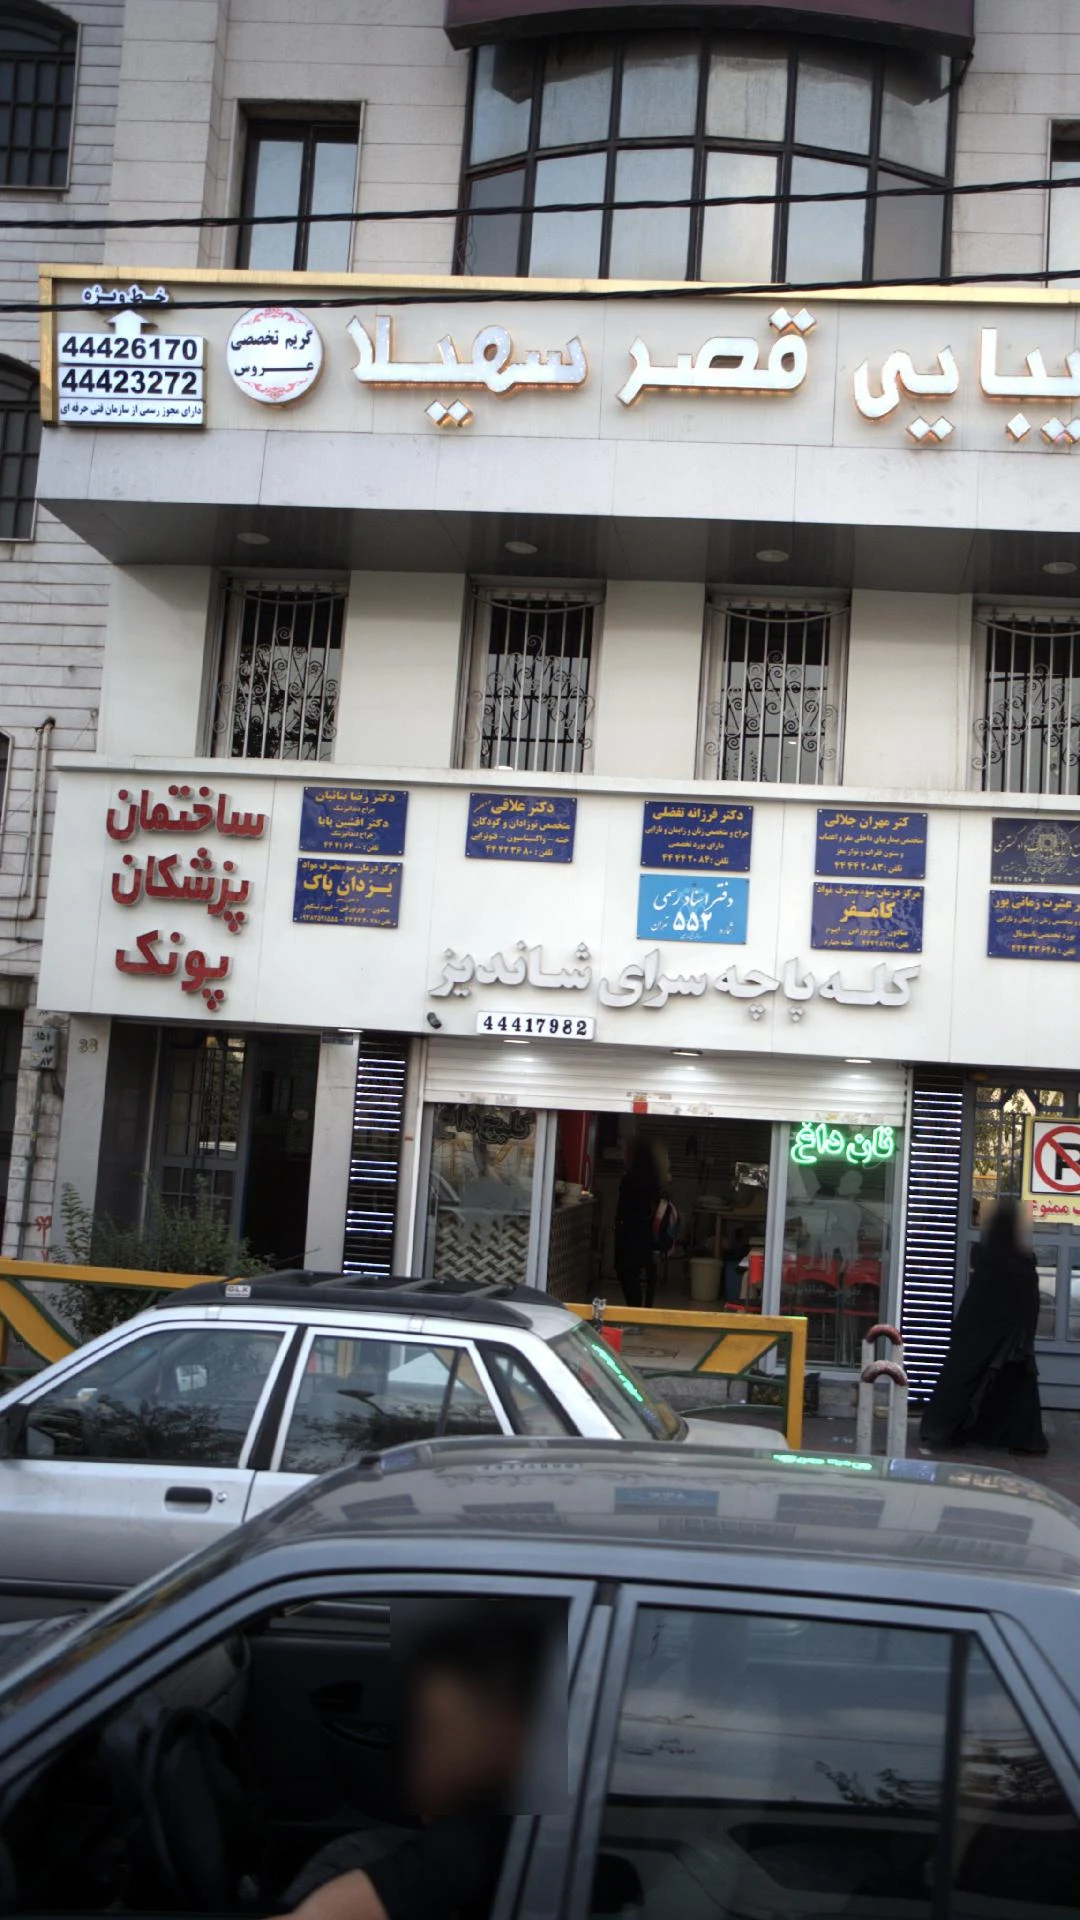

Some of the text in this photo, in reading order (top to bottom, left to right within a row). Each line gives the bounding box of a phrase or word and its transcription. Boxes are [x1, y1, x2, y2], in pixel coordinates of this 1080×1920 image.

[231, 329, 313, 351] گریم تخصصی
[62, 337, 197, 360] 44426170
[234, 362, 314, 376] عروس
[346, 307, 1080, 443] یبایی قصر سهیلا
[62, 369, 197, 395] 44423272
[91, 404, 104, 416] فنی
[106, 403, 129, 416] سازمان
[131, 404, 138, 416] از
[140, 406, 160, 417] رسمی
[162, 406, 179, 418] مجوز
[181, 404, 202, 418] دارای
[372, 793, 396, 804] دکتر
[106, 785, 268, 841] ساختمان
[528, 800, 555, 816] دکتر
[687, 807, 718, 822] فرزانه
[472, 816, 501, 828] کودکان
[720, 809, 744, 823] دکتر
[824, 813, 857, 828] جلالی
[367, 819, 389, 830] دکتر
[540, 821, 570, 831] متخصص
[111, 847, 253, 932] پزشکان
[303, 873, 393, 898] یزدان پاک
[653, 881, 734, 912] دفتر اسناد رسمی
[673, 911, 712, 932] ۵۵۲
[115, 930, 231, 1011] پونک
[428, 940, 922, 1023] کله پاچه سرای شاندیز
[483, 1015, 587, 1036] 44417982
[791, 1121, 845, 1164] داغ
